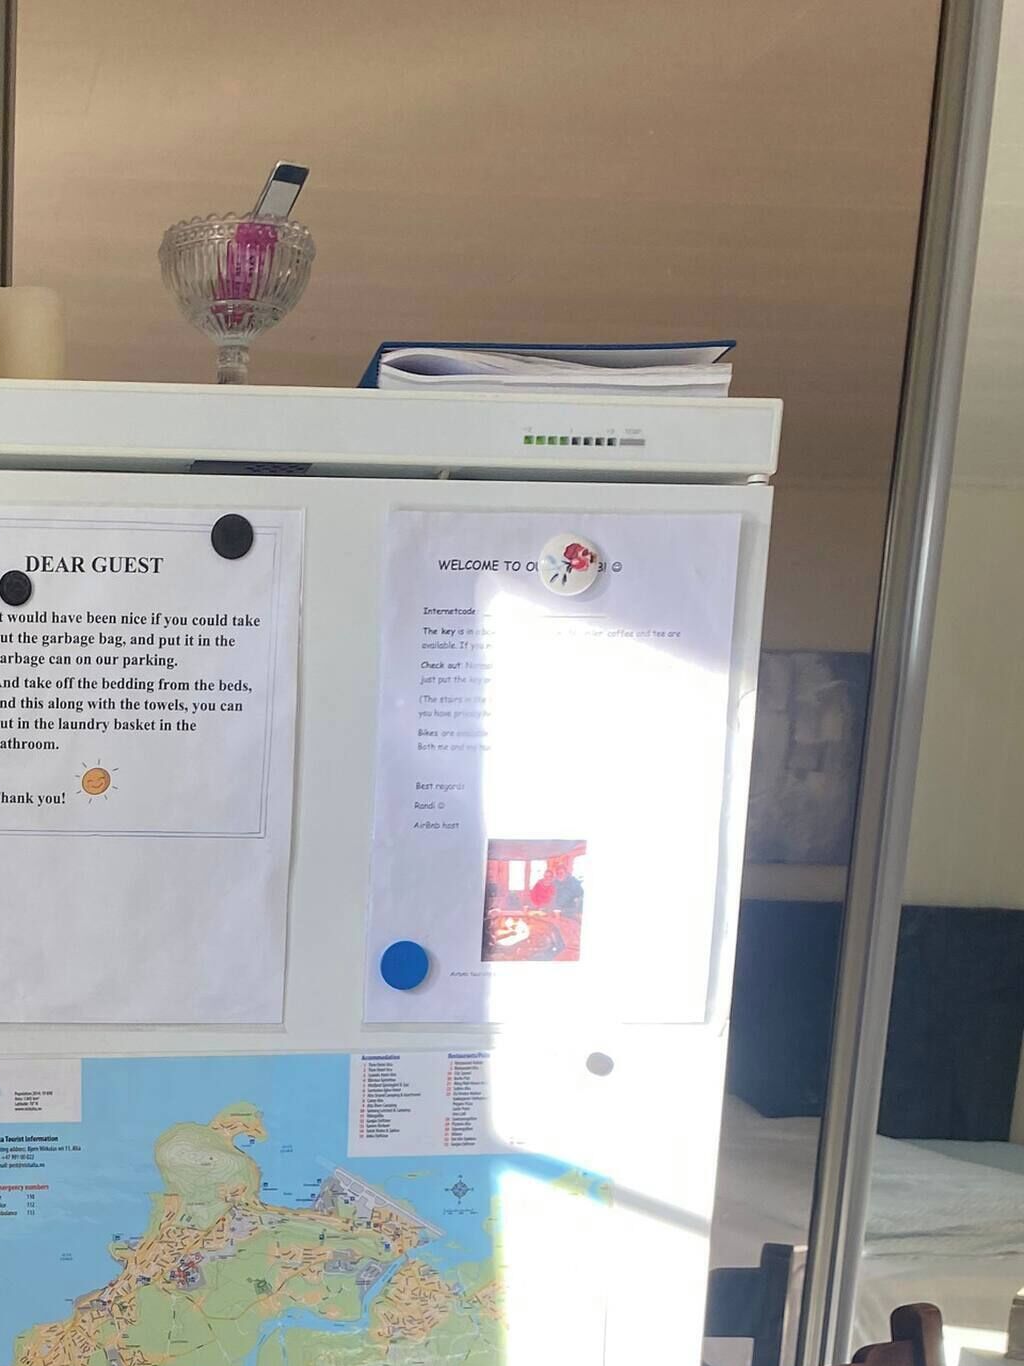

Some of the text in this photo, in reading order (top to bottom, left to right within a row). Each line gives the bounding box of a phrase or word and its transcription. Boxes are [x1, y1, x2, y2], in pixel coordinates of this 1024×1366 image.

[26, 556, 163, 574] DEAR GUEST
[439, 559, 499, 571] WELCOME
[504, 561, 521, 571] TO
[7, 611, 47, 624] would
[51, 612, 82, 624] have
[87, 612, 116, 625] been
[121, 613, 147, 625] nice
[151, 613, 162, 625] if
[164, 616, 187, 628] you
[192, 614, 227, 626] could
[232, 615, 261, 627] take
[423, 627, 438, 635] The
[441, 628, 456, 637] key
[607, 630, 634, 638] coffee
[18, 632, 38, 643] the
[41, 633, 95, 647] garbage
[99, 633, 126, 647] bag,
[130, 634, 154, 645] and
[159, 636, 181, 649] put
[184, 635, 195, 646] it
[198, 635, 210, 646] in
[215, 635, 235, 647] the
[48, 656, 71, 665] can
[76, 656, 92, 665] on
[96, 657, 119, 666] our
[123, 654, 178, 669] parking.
[420, 661, 444, 669] Check
[24, 676, 52, 689] take
[55, 676, 75, 689] off
[77, 676, 98, 689] the
[102, 677, 155, 692] bedding
[158, 678, 190, 691] from
[194, 679, 215, 691] the
[219, 679, 252, 693] beds,
[20, 697, 44, 709] this
[48, 698, 84, 712] along
[87, 699, 116, 710] with
[119, 699, 141, 711] the
[144, 699, 189, 713] towels,
[192, 703, 216, 715] you
[220, 703, 243, 712] can
[17, 718, 30, 730] in
[34, 718, 55, 730] the
[58, 718, 110, 733] laundry
[113, 719, 156, 731] basket
[159, 720, 172, 731] in
[176, 720, 197, 732] the
[416, 782, 433, 790] Best
[37, 792, 66, 807] you!
[414, 801, 435, 809] Randi
